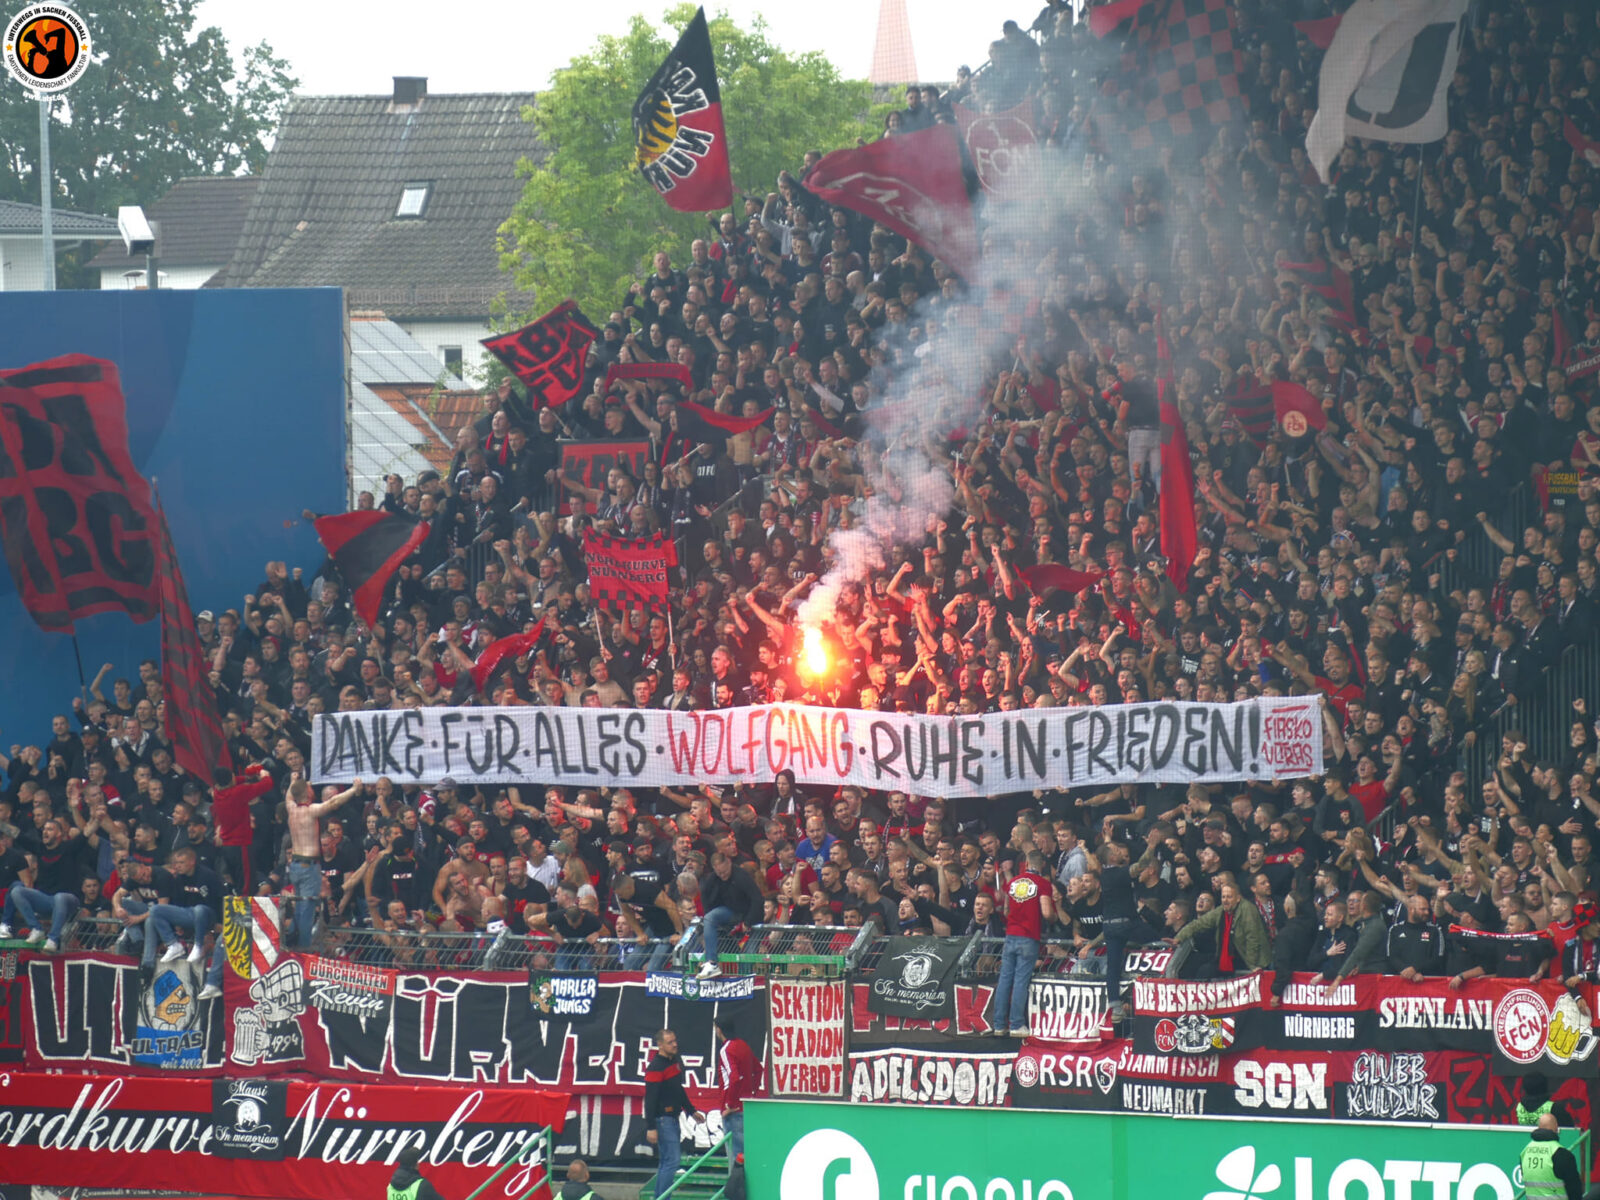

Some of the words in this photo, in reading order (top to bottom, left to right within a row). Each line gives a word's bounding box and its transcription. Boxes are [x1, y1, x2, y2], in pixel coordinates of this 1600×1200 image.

[1263, 717, 1313, 740] FIASKO
[321, 711, 424, 778] DANKE
[443, 713, 521, 777] FÜR
[535, 711, 647, 778] ALLES
[667, 706, 852, 778] WOLFGANG
[870, 719, 985, 786] RUHE
[1002, 717, 1047, 781] IN
[1065, 703, 1260, 781] FRIEDEN!
[1262, 741, 1313, 768] ULTRAS
[1124, 952, 1172, 972] 030
[309, 961, 389, 990] DURCHHALTEN
[550, 977, 597, 998] MARLER
[309, 980, 384, 1011] Kevin
[771, 983, 844, 1022] SEKTION
[875, 979, 896, 996] In
[897, 988, 947, 1001] memoriam
[1134, 979, 1156, 1011] DIE
[1157, 974, 1261, 1012] BESESSENEN
[1283, 984, 1357, 1006] OLDSCHOOL
[553, 998, 591, 1014] JUNGS
[1285, 1013, 1355, 1038] NÜRNBERG
[1509, 1016, 1541, 1046] FCN
[131, 1031, 204, 1057] ULTRAS
[271, 1033, 299, 1053] 1994
[773, 1026, 843, 1058] STADION
[1157, 1035, 1174, 1047] FCN
[160, 1057, 178, 1070] seit
[179, 1057, 203, 1070] 2002
[1020, 1069, 1034, 1078] FCN
[1040, 1054, 1093, 1087] RSR
[1353, 1052, 1427, 1085] GLUBB
[229, 1080, 268, 1097] Mausi
[774, 1064, 843, 1093] VERBOT
[851, 1056, 1013, 1105] ADELSDORF
[1233, 1060, 1328, 1110] SGN
[1123, 1083, 1207, 1115] NEUMARKT
[0, 1078, 213, 1154] ordkurve
[284, 1087, 547, 1196] Nürnberg
[215, 1125, 231, 1141] In
[232, 1132, 279, 1145] memoriam
[1528, 1157, 1544, 1170] 191
